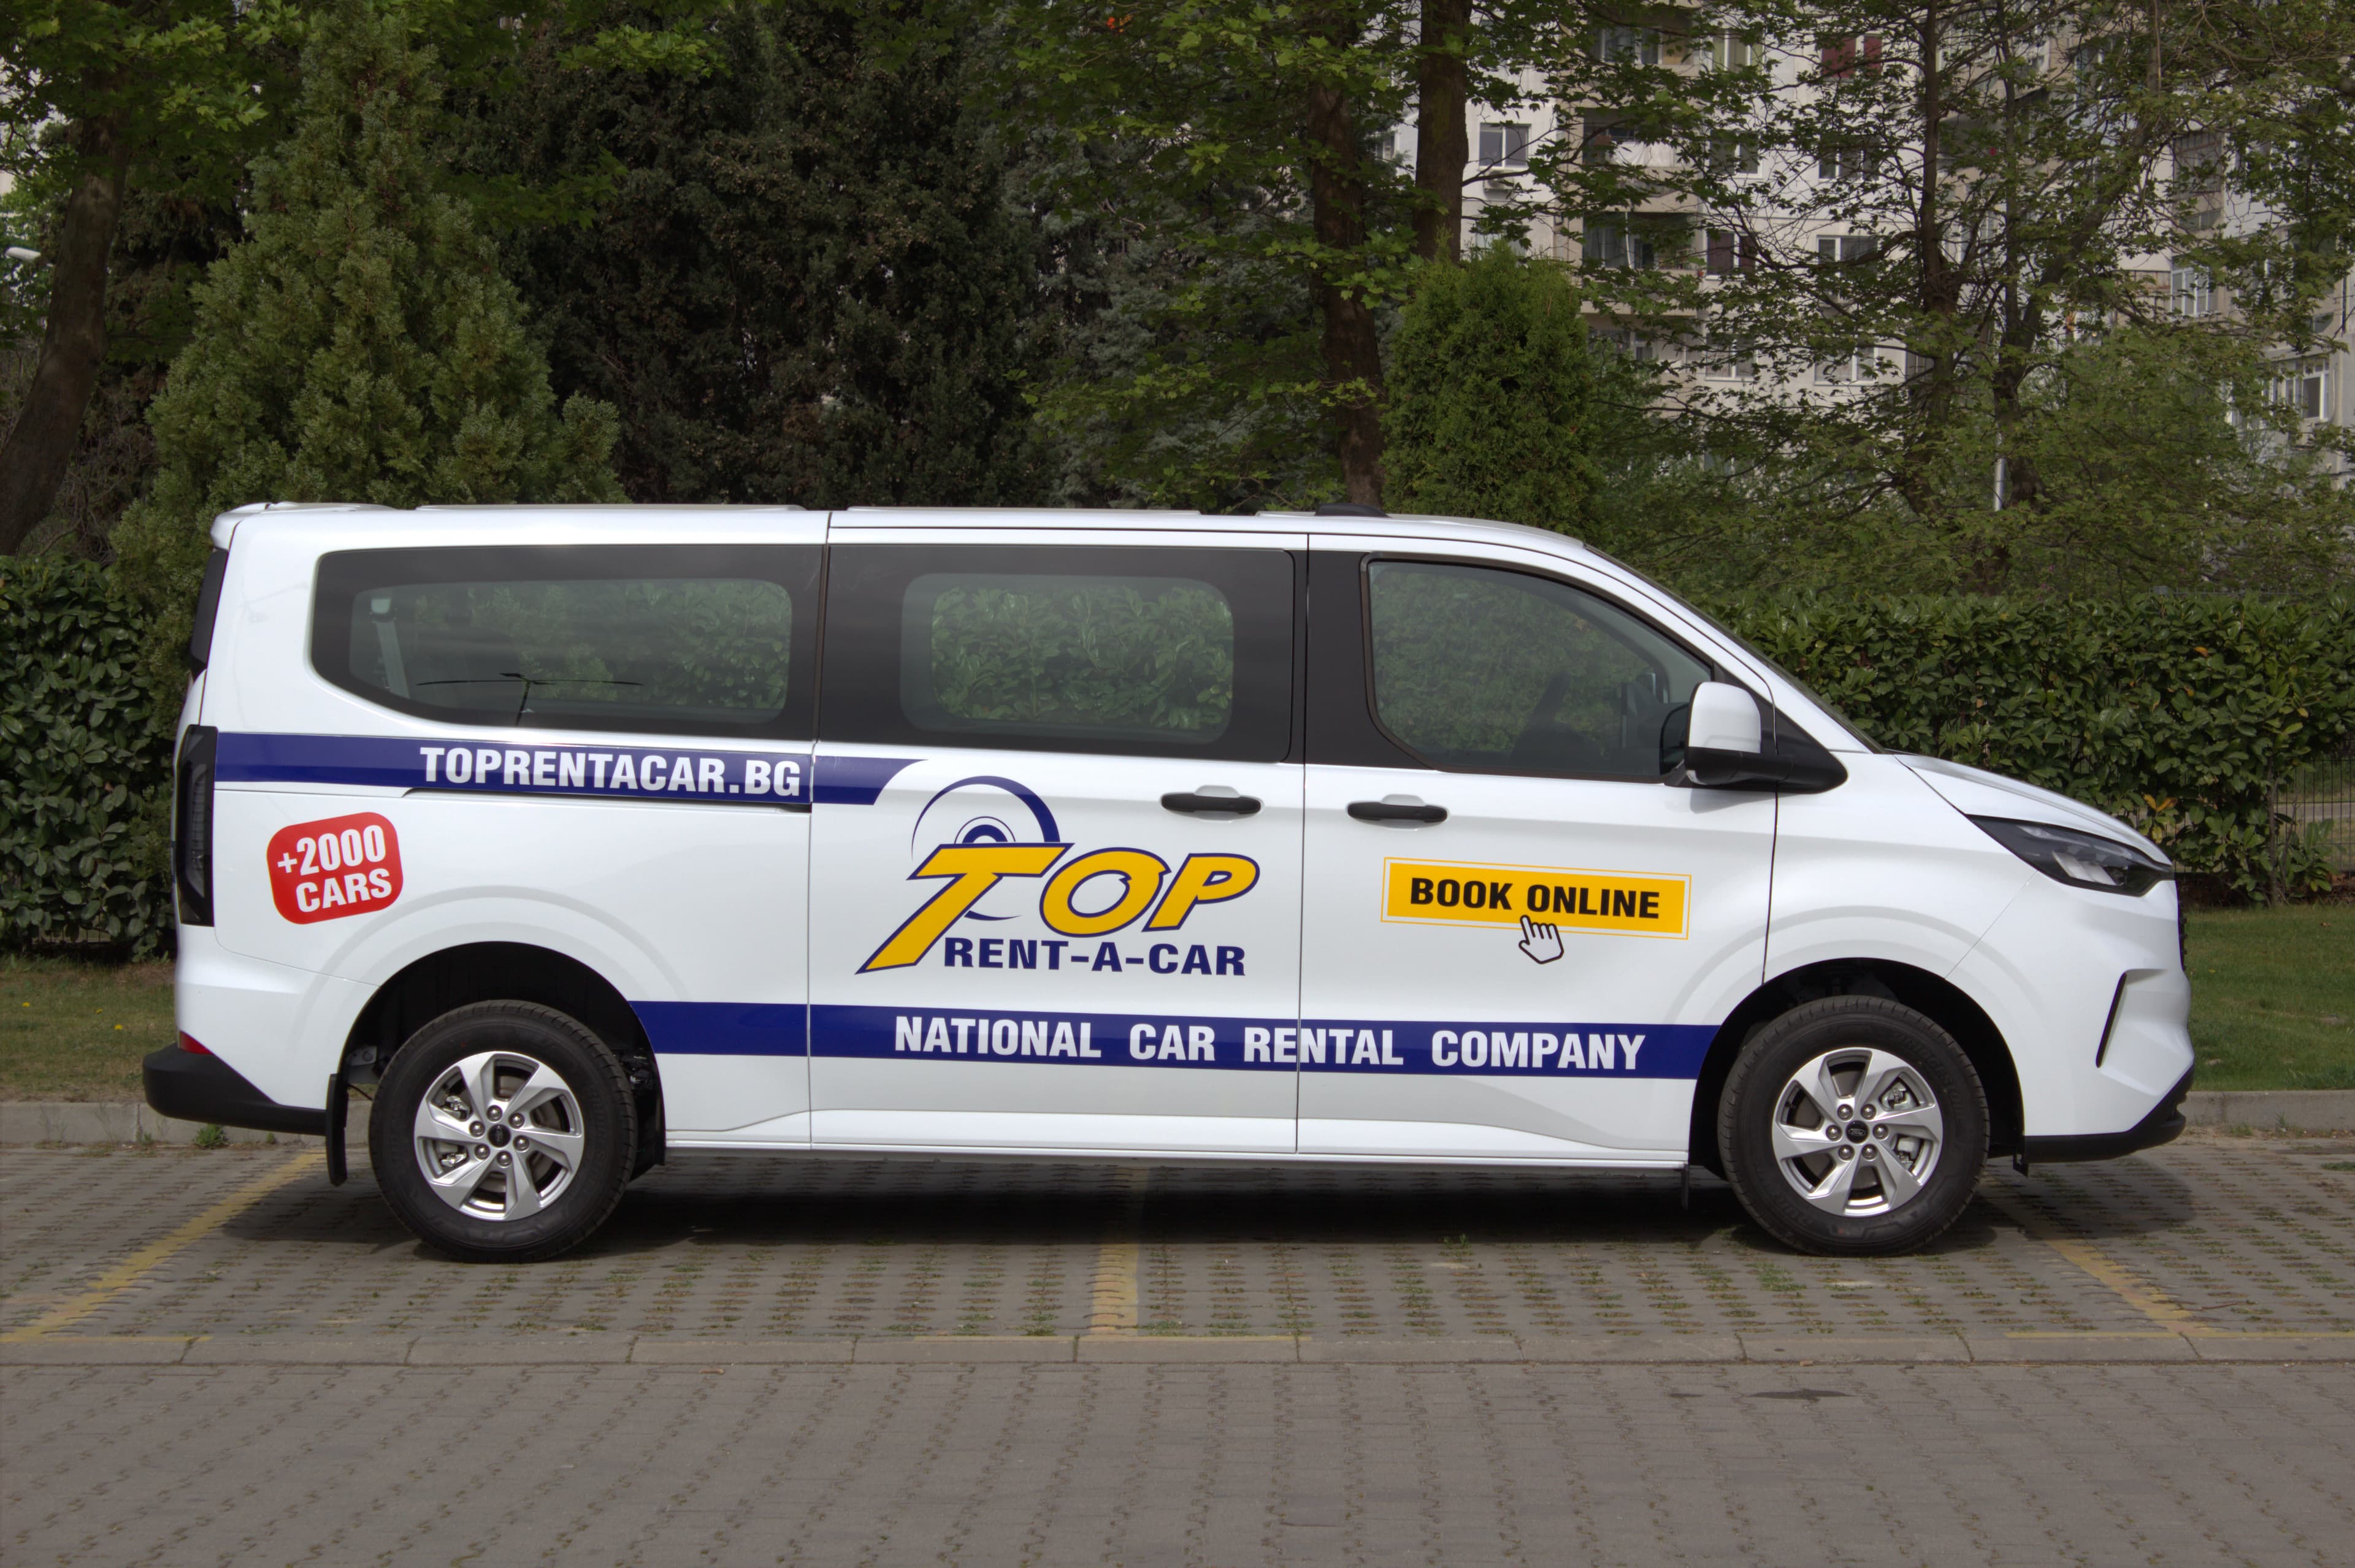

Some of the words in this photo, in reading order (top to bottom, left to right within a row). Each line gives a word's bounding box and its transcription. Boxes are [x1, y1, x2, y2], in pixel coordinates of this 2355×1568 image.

[419, 746, 800, 797] TOPRENTACAR.BG
[277, 824, 386, 877] +2000
[296, 868, 392, 914] CARS
[854, 843, 1261, 976] TOP
[1410, 878, 1513, 911] BOOK
[1526, 884, 1660, 919] ONLINE
[944, 937, 1246, 976] RENT-A-CAR
[895, 1016, 1101, 1059] NATIONAL
[1129, 1023, 1216, 1061] CAR
[1243, 1027, 1404, 1065] RENTAL
[1431, 1030, 1646, 1070] COMPANY
